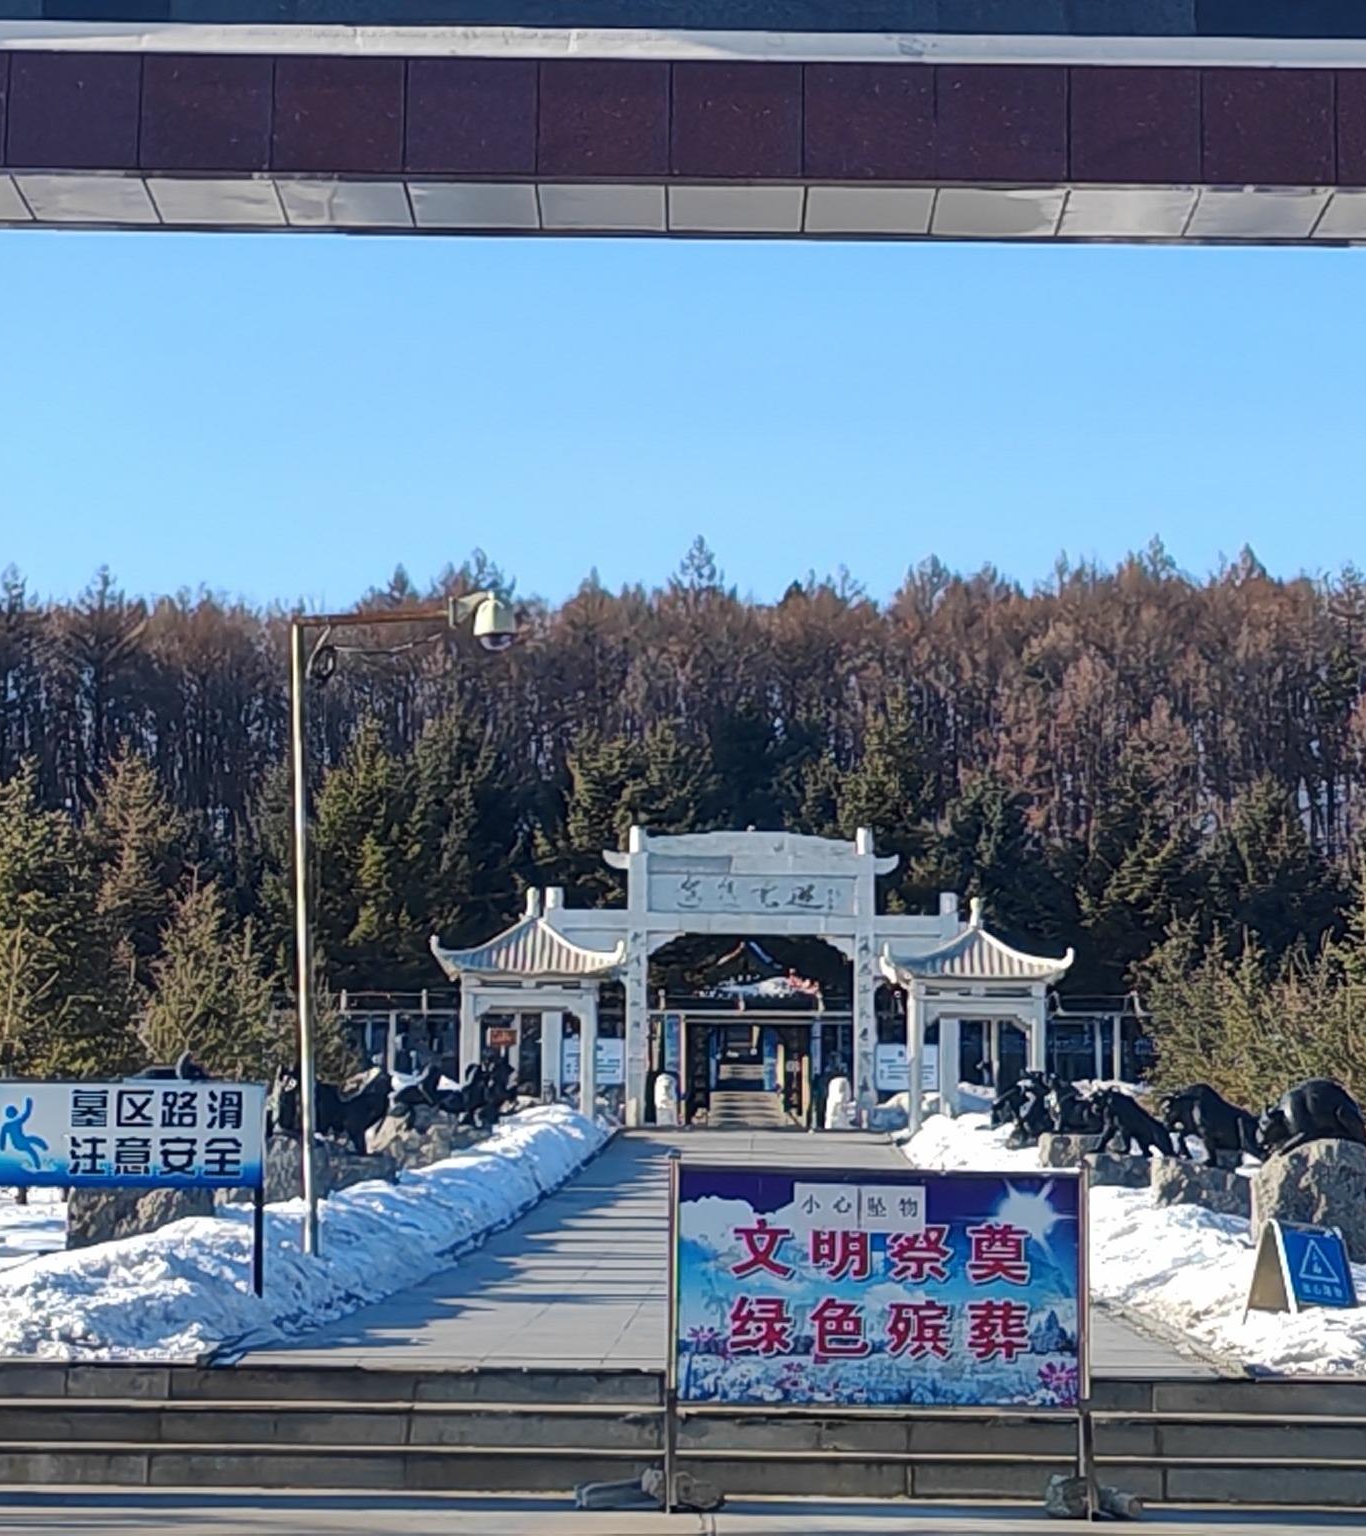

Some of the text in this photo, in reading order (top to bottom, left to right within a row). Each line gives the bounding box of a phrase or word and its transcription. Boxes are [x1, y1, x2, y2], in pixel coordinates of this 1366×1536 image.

[71, 1089, 243, 1129] 墓区路滑
[68, 1136, 243, 1177] 注意安全
[801, 1194, 918, 1218] 小心坠物
[732, 1219, 1030, 1284] 文明祭奠
[730, 1296, 1030, 1360] 绿色殡葬
